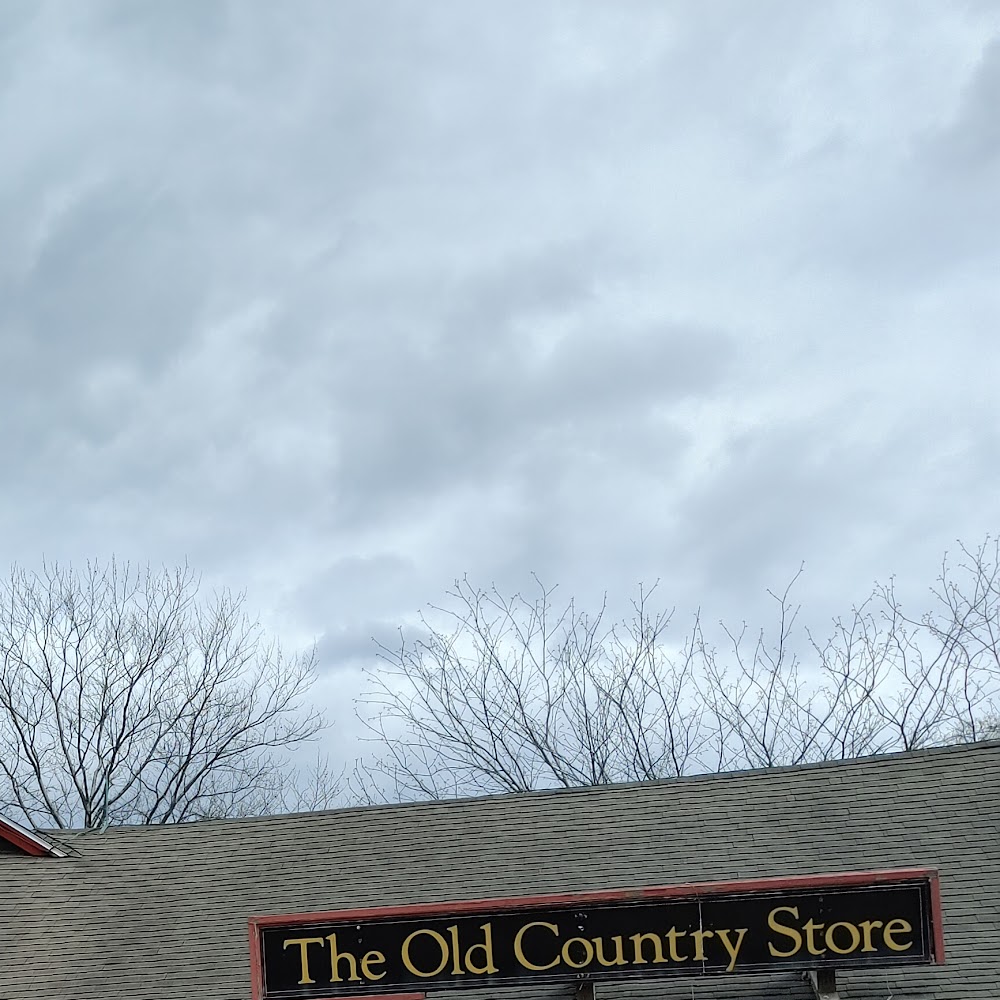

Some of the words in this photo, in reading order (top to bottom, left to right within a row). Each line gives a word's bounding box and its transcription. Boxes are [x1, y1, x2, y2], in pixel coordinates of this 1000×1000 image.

[283, 934, 388, 985] The
[400, 922, 499, 979] Old
[513, 920, 747, 973] Country
[766, 905, 913, 958] Store
